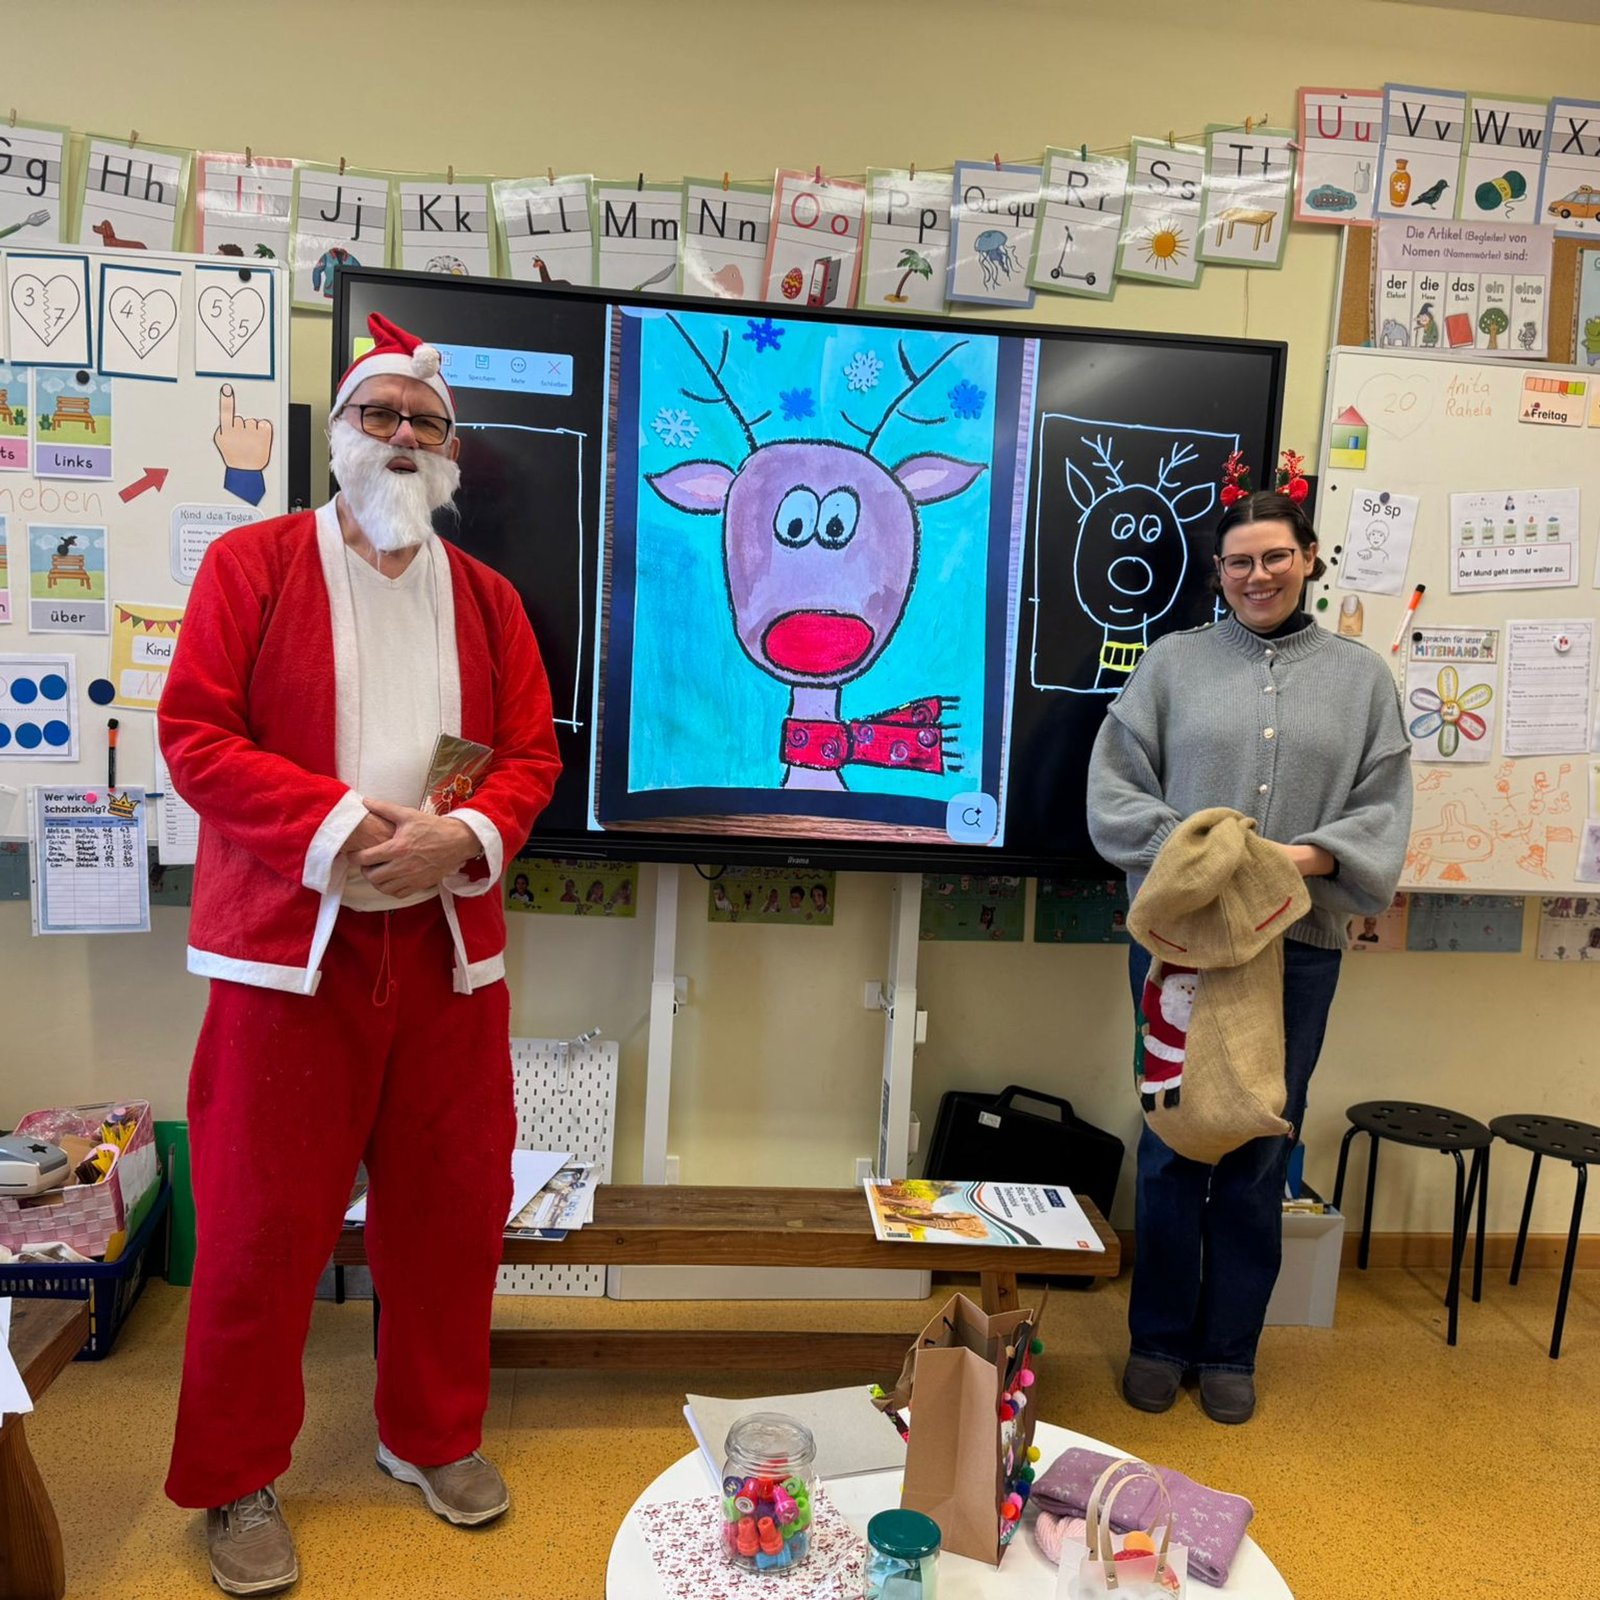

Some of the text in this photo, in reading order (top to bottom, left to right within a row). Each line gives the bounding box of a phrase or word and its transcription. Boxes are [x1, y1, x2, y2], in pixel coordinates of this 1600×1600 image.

[1406, 225, 1527, 245] Die Artikel (Begleiter) von
[1402, 244, 1528, 261] Nomen (Namenwörter) sind:
[1387, 274, 1407, 290] der
[1420, 275, 1439, 291] die
[1451, 277, 1475, 292] das
[1485, 281, 1505, 294] ein
[1515, 282, 1543, 296] eine
[24, 287, 35, 307] 3
[120, 300, 133, 318] 4
[210, 299, 223, 318] 5
[54, 308, 65, 327] 7
[148, 321, 161, 340] 6
[238, 320, 249, 338] 5
[1447, 372, 1490, 395] Anita
[1384, 392, 1417, 414] 20
[1530, 407, 1568, 423] Freitag
[54, 453, 93, 469] links
[180, 510, 201, 520] Kind
[1362, 499, 1401, 518] Sp sp
[1493, 568, 1509, 577] geht
[1510, 567, 1531, 575] immer
[51, 610, 86, 623] über
[146, 642, 171, 657] Kind
[44, 793, 64, 801] Wer
[45, 805, 107, 815] Schätzkönig?
